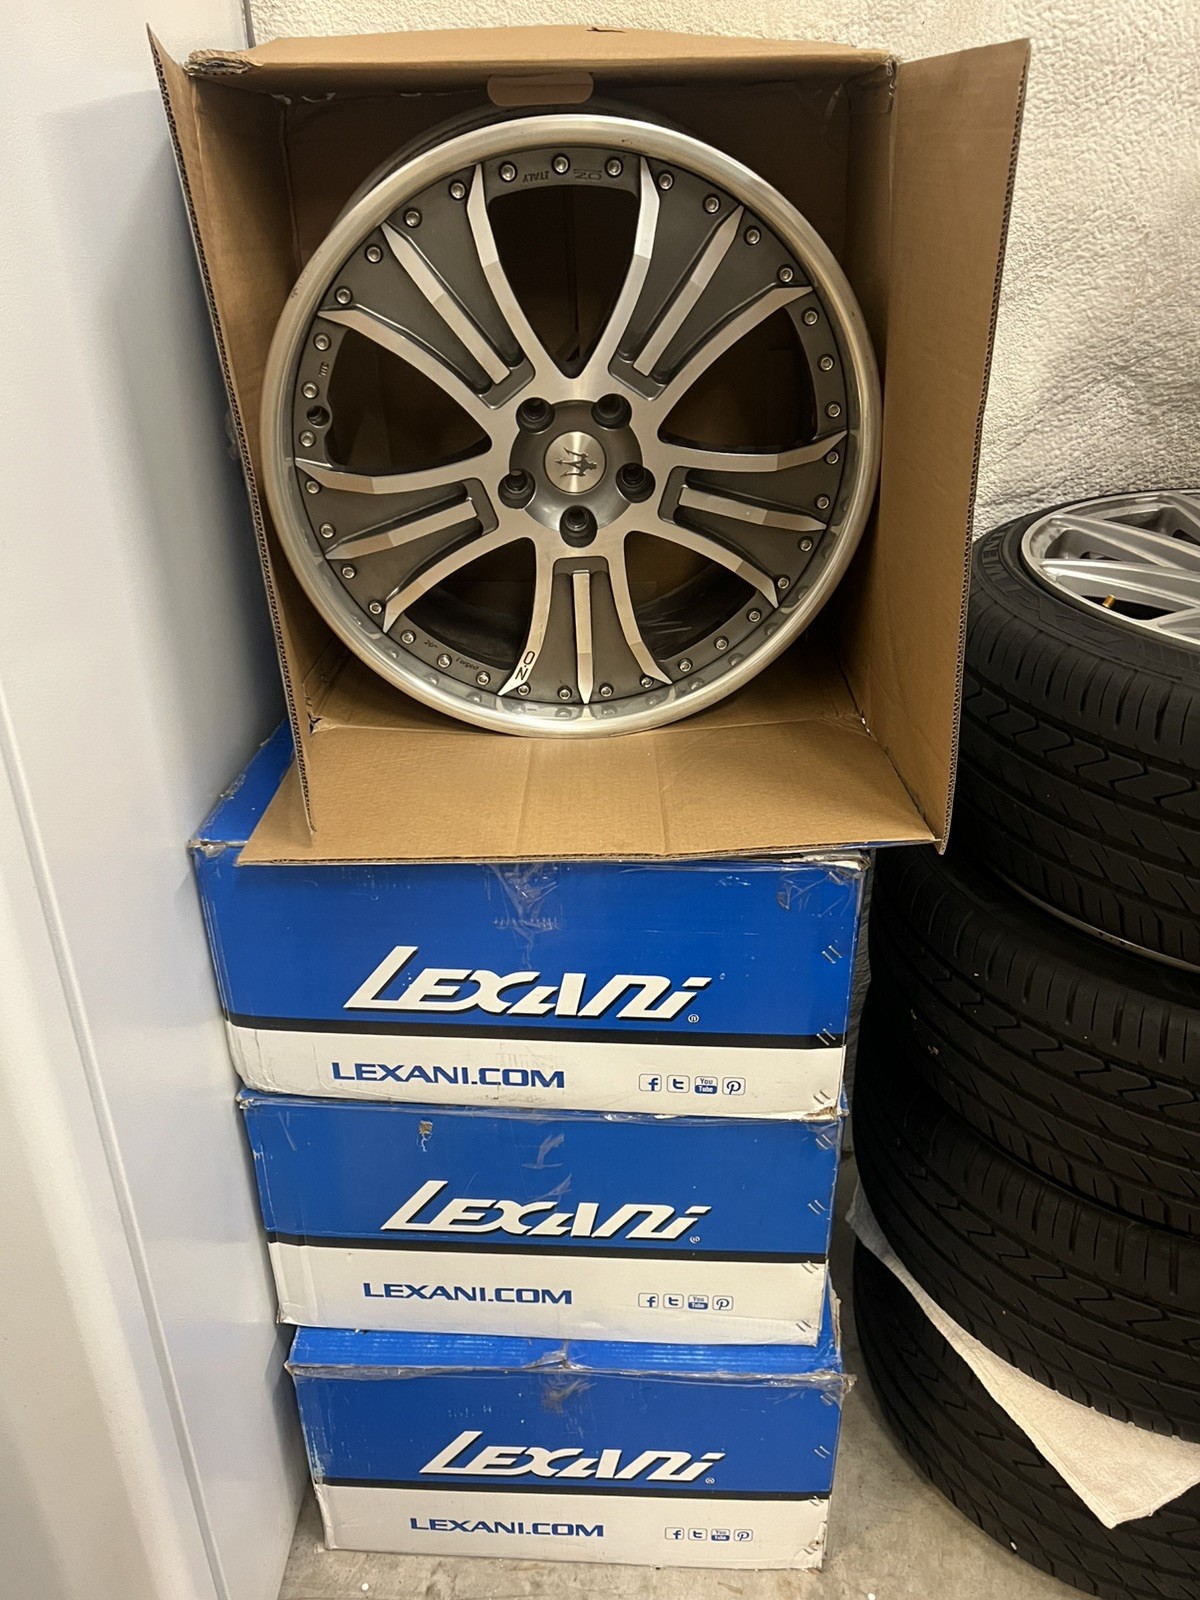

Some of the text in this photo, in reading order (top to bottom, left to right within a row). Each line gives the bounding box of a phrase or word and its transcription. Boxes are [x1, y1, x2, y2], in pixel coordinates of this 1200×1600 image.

[522, 170, 550, 184] ITALY
[332, 1062, 564, 1088] LEXANI.COM
[363, 1282, 573, 1304] LEXANI.COM
[410, 1517, 604, 1537] LEXANI.COM
